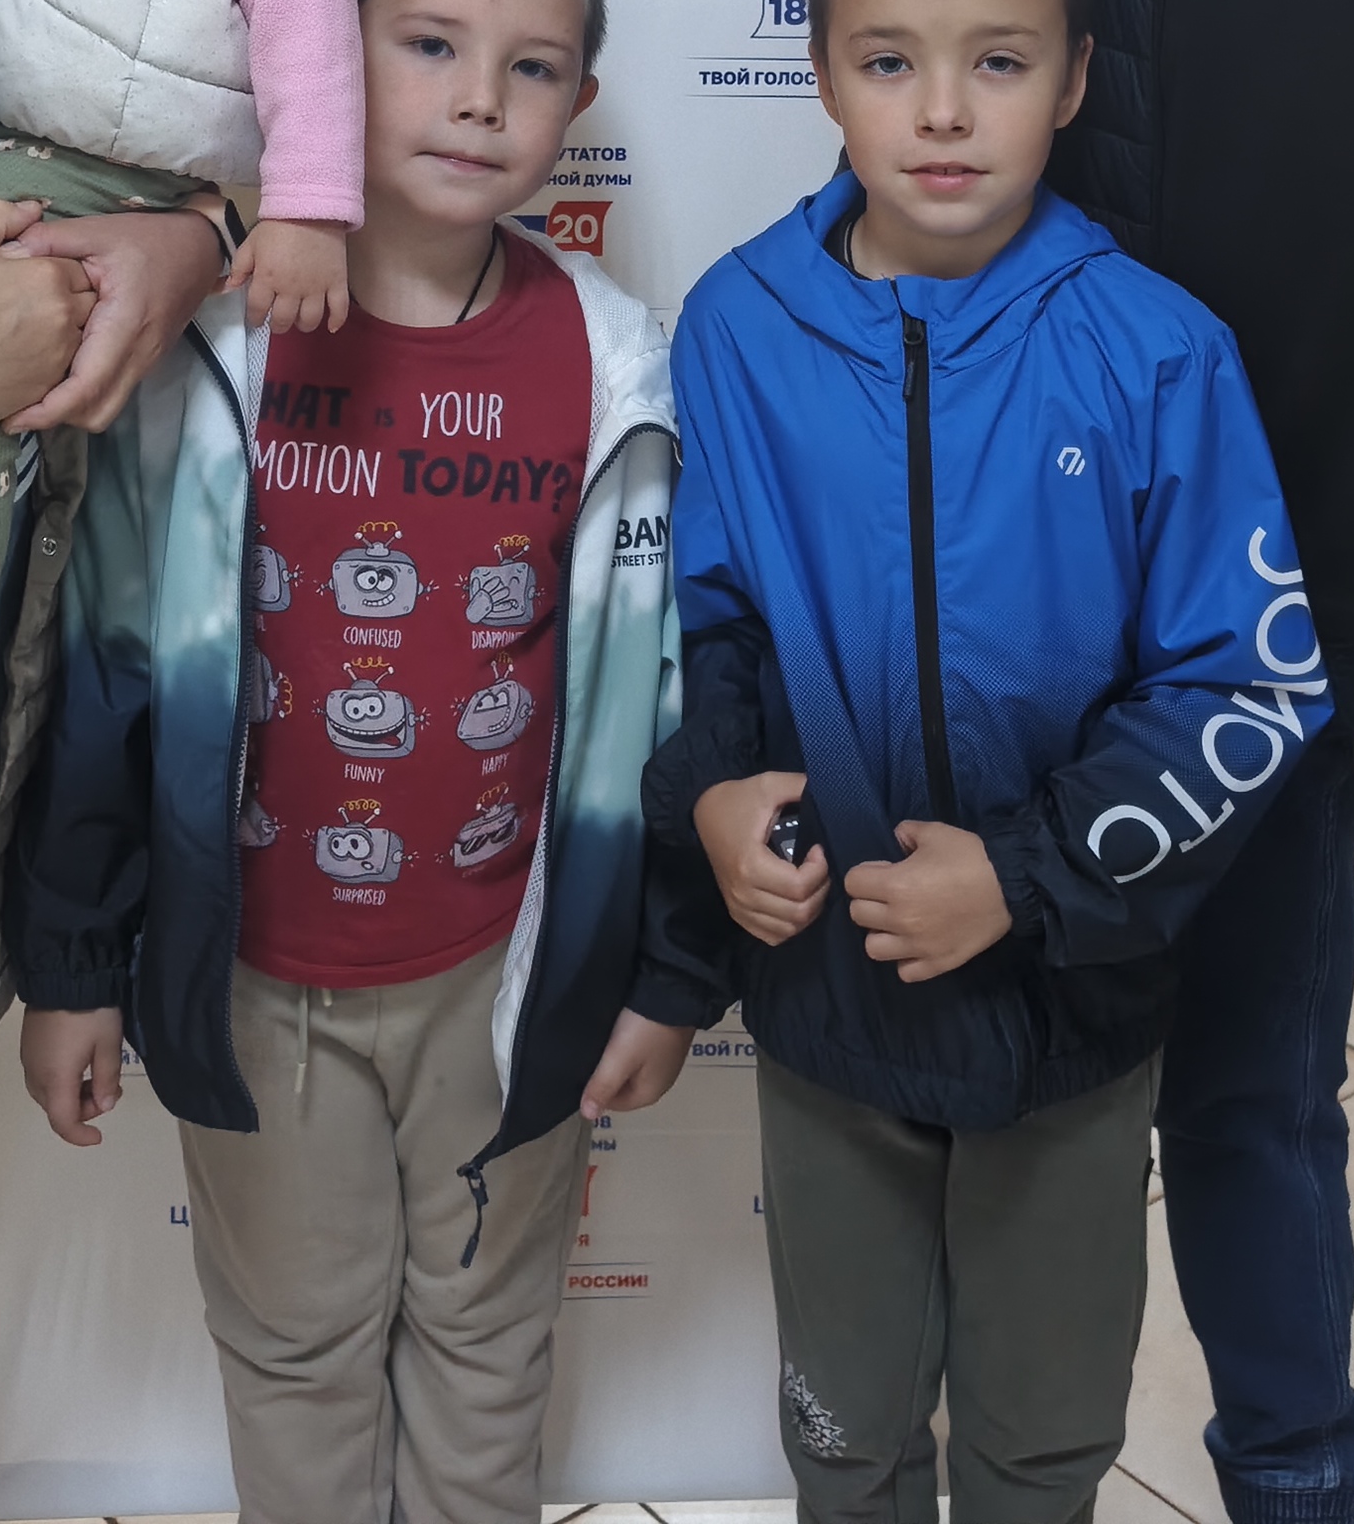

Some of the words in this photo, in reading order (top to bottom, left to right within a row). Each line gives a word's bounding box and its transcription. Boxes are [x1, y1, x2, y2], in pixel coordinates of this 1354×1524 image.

[698, 67, 750, 86] ТВОЙ
[754, 70, 817, 86] ГОЛОС
[557, 147, 628, 162] УТАТОВ
[547, 170, 581, 186] НОЙ
[583, 173, 633, 188] ДУМЫ
[552, 213, 599, 245] 20
[260, 381, 352, 429] HAT
[420, 391, 504, 441] YOUR
[251, 439, 382, 498] MOTION
[397, 448, 573, 514] TODAY?
[610, 554, 646, 569] STREET
[343, 625, 402, 649] CONFUSED
[344, 763, 386, 784] FUNNY
[481, 752, 511, 777] HAPPY
[332, 885, 387, 906] SURPRISED
[692, 1040, 730, 1057] ВОЙ
[735, 1043, 757, 1057] ГО
[567, 1274, 649, 1290] РОССИИ!
